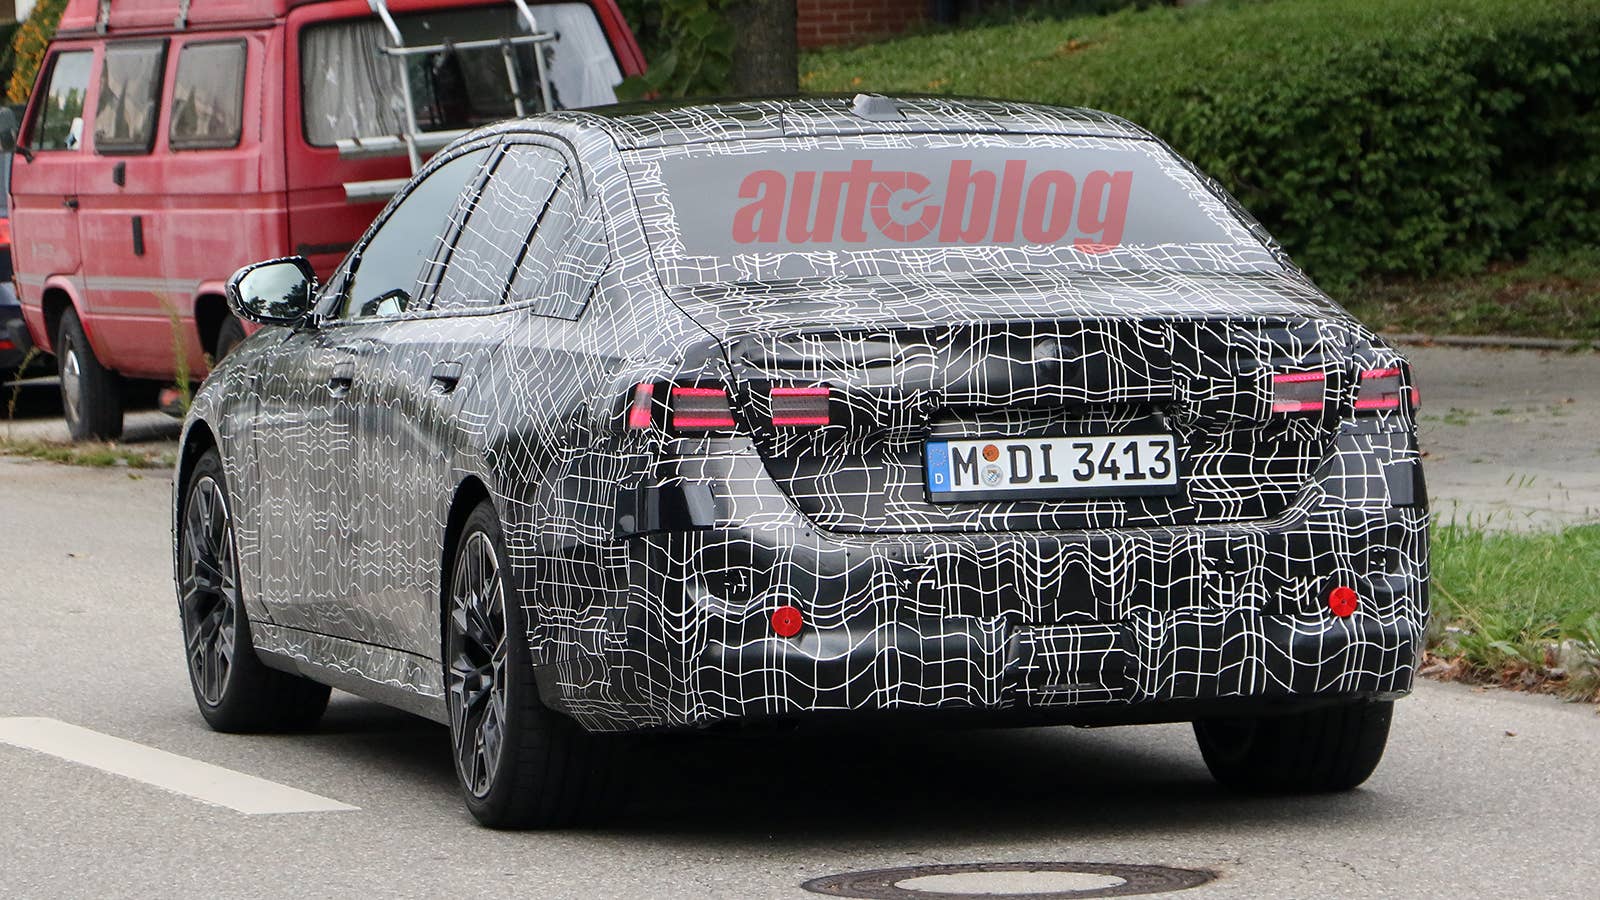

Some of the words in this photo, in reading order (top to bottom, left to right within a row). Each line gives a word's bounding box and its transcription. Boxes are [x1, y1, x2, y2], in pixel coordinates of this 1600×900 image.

[951, 446, 979, 486] M
[1006, 443, 1059, 483] DI
[1072, 440, 1172, 482] 3413
[934, 472, 944, 484] D
